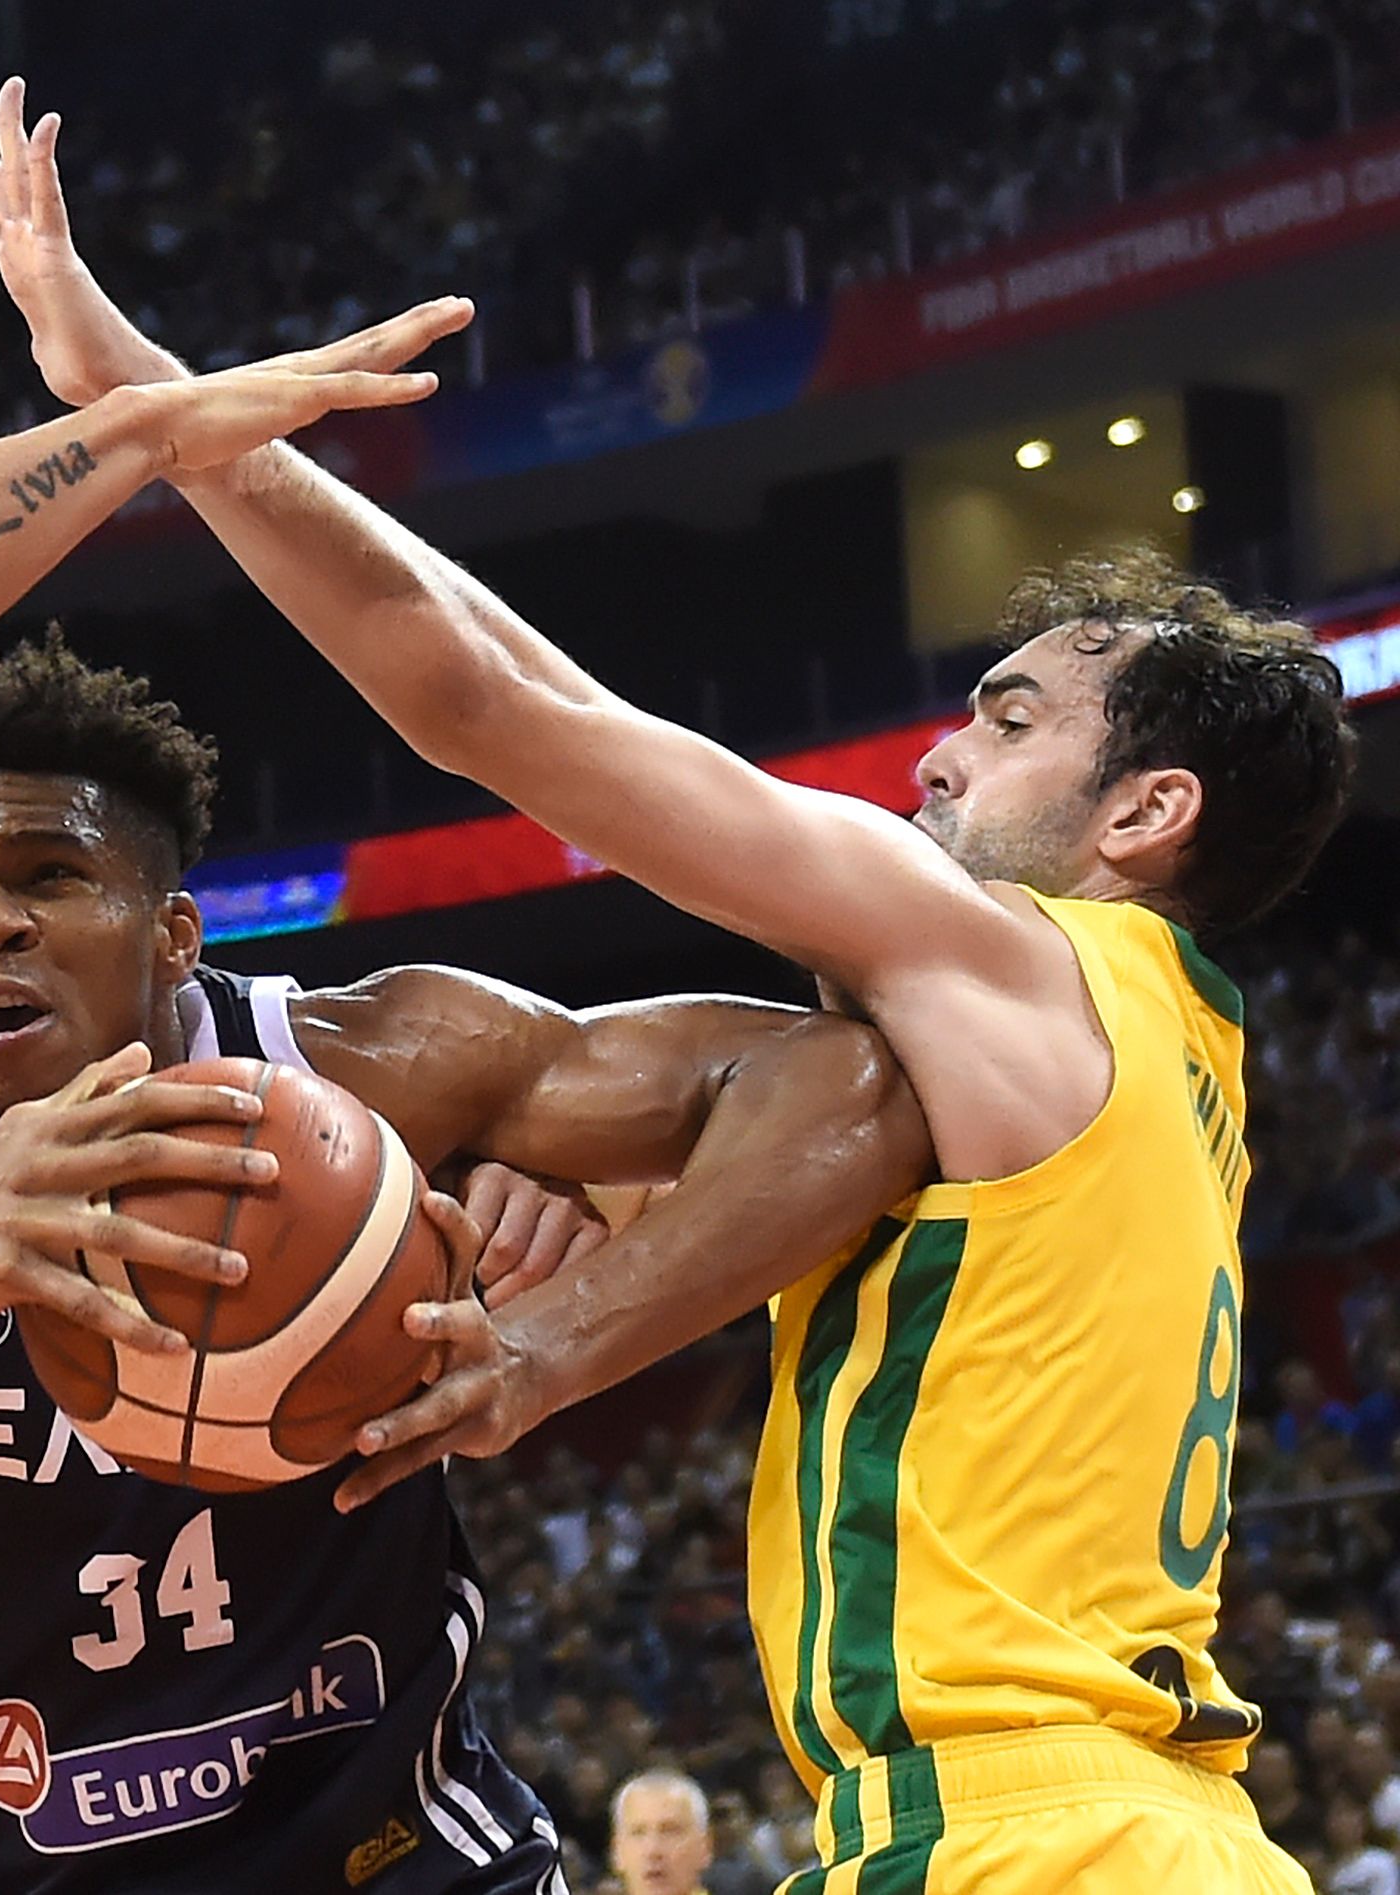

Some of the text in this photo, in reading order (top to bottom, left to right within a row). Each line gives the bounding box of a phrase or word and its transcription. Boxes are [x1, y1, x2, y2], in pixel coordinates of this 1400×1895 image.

[1158, 1265, 1238, 1590] 8
[71, 1507, 235, 1672] 34
[72, 1665, 348, 1827] Eurobk
